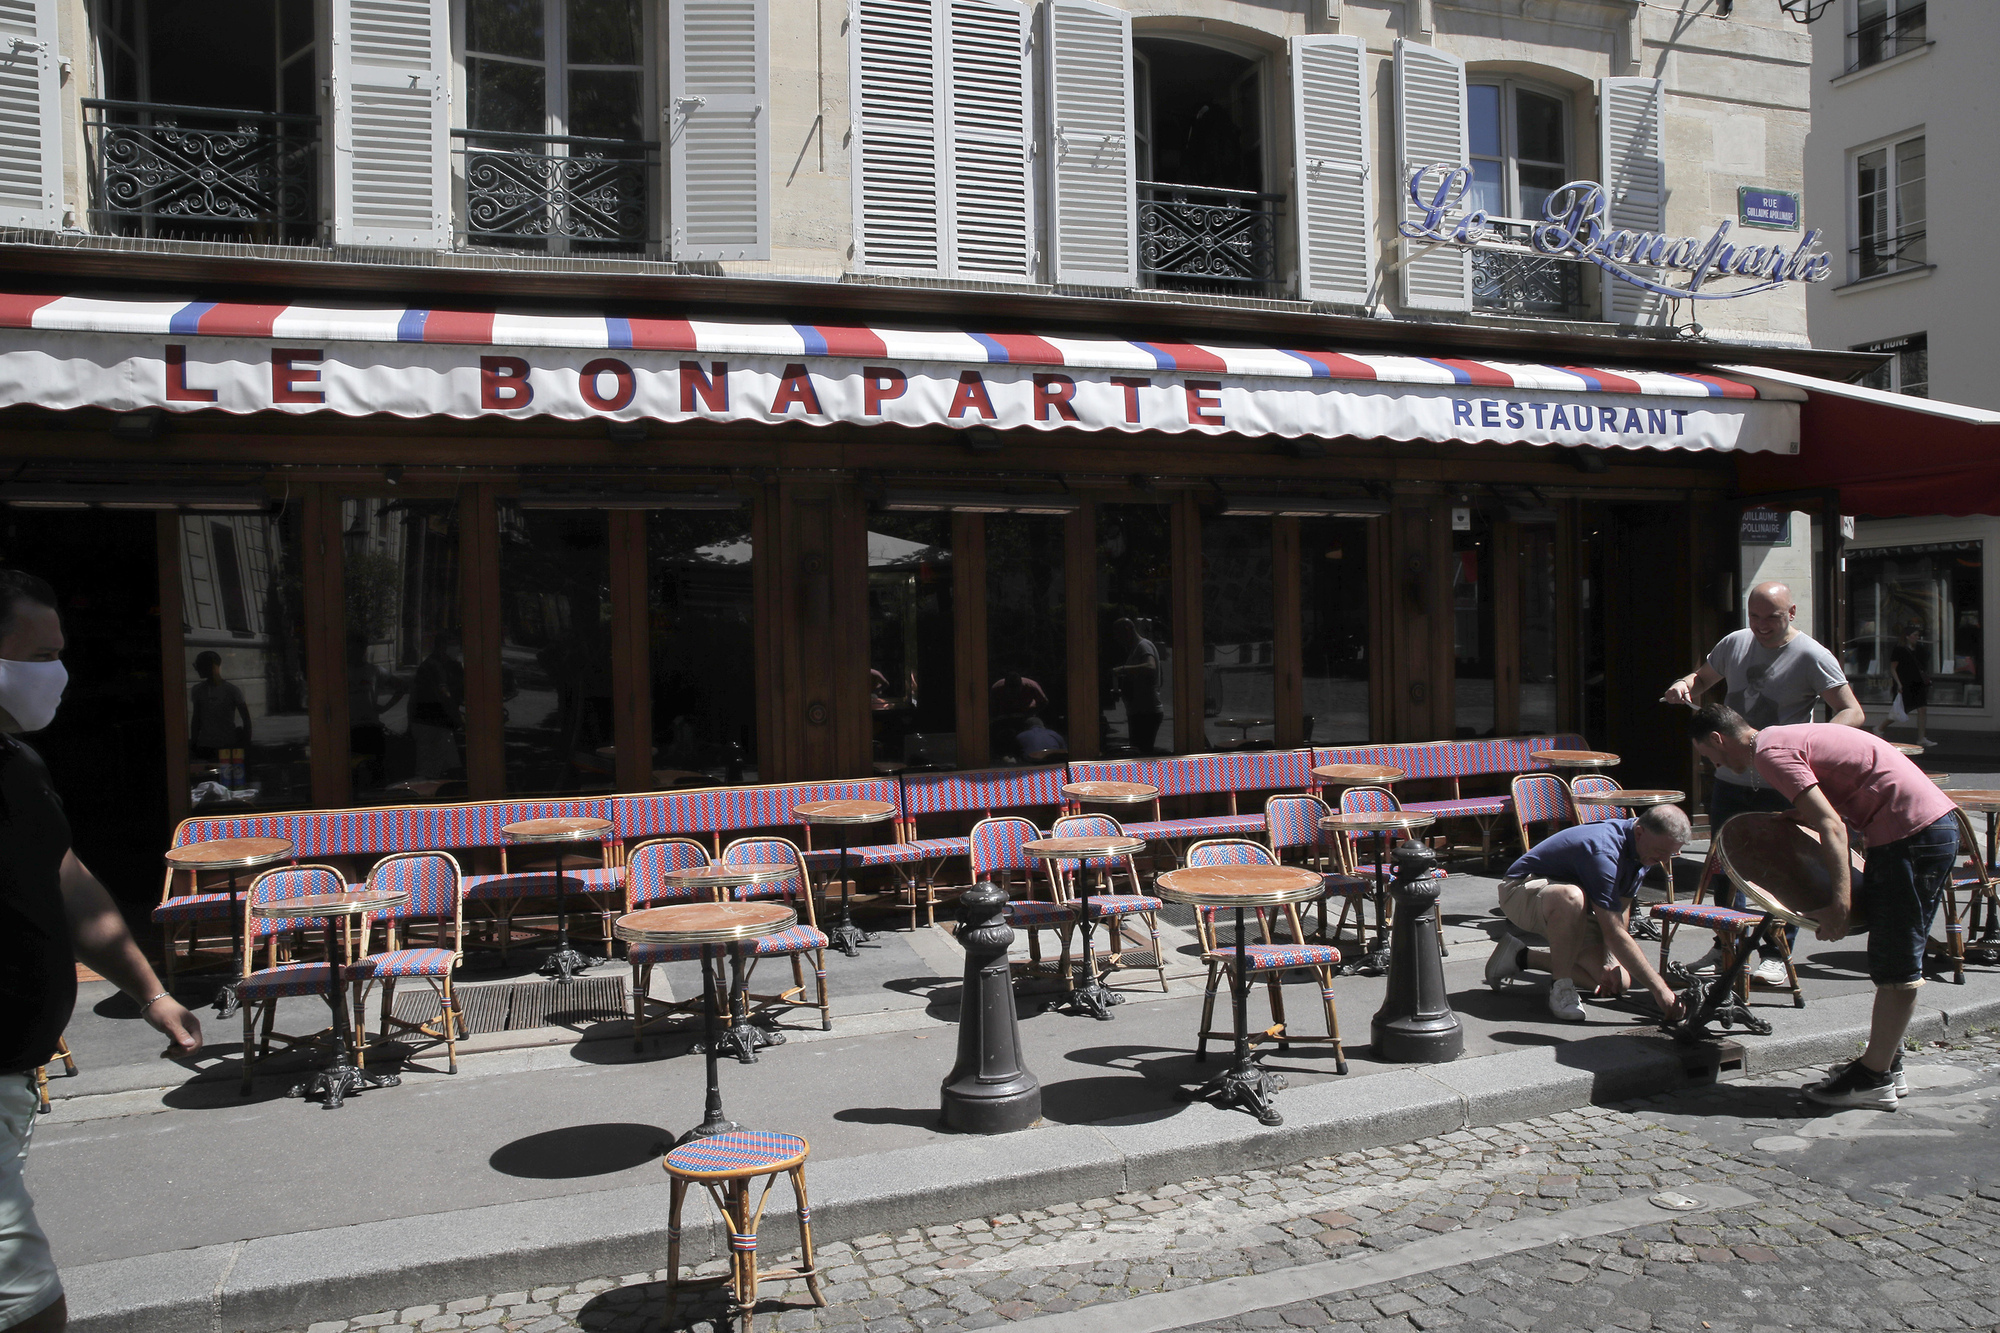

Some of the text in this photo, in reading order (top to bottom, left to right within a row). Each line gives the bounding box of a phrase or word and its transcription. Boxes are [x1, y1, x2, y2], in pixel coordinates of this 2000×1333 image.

[1747, 207, 1794, 221] GUILLAUME APOLLINAIRE
[1762, 198, 1778, 208] RUE
[1399, 163, 1833, 299] Le Bonaparte
[165, 344, 1226, 427] LE BONAPARTE
[1451, 399, 1689, 436] RESTAURANT
